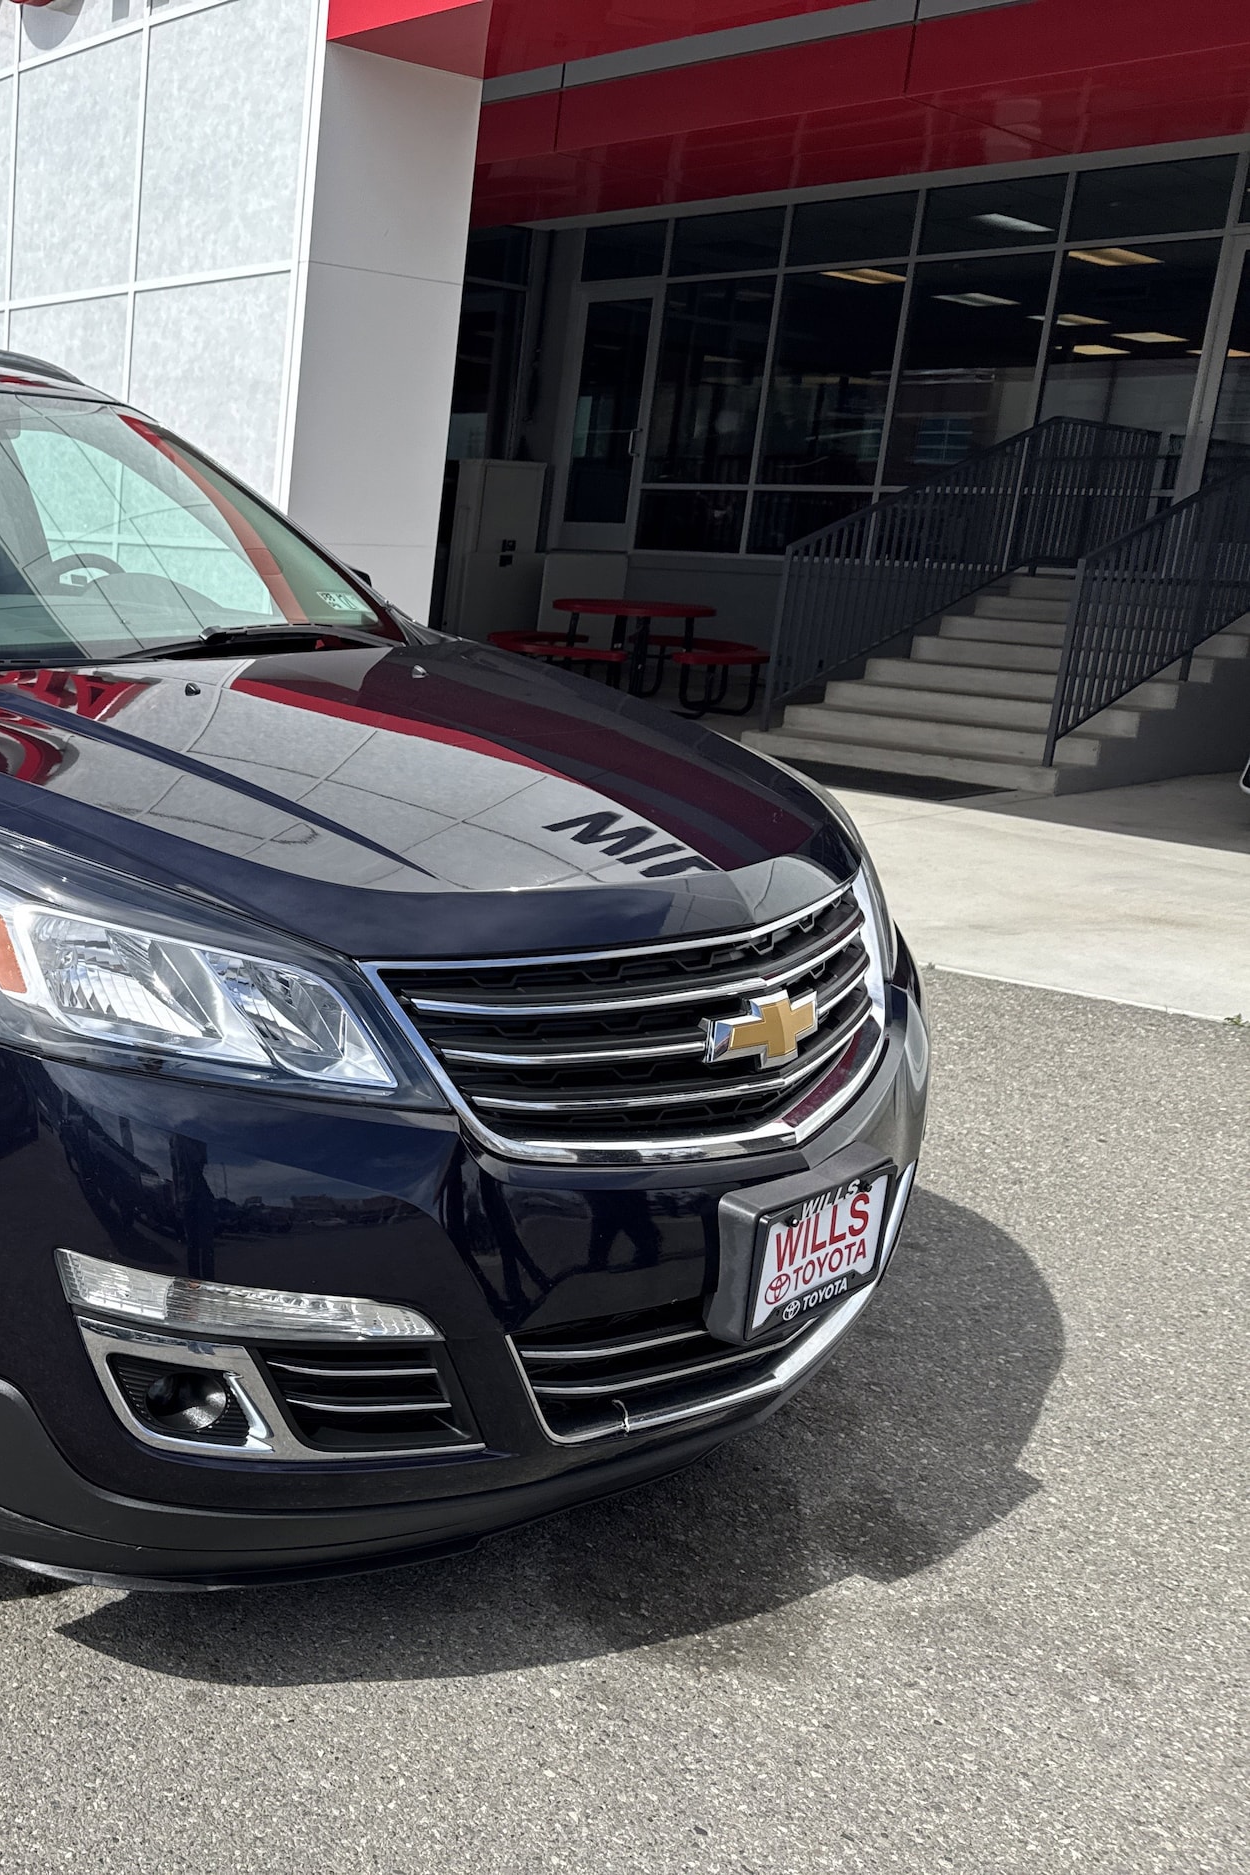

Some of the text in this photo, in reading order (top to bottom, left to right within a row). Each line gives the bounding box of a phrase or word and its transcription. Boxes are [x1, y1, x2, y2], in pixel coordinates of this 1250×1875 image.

[801, 1178, 861, 1221] WILLS
[775, 1191, 871, 1273] WILLS
[793, 1237, 867, 1291] TOYOTA
[802, 1276, 848, 1311] TOYOTA
